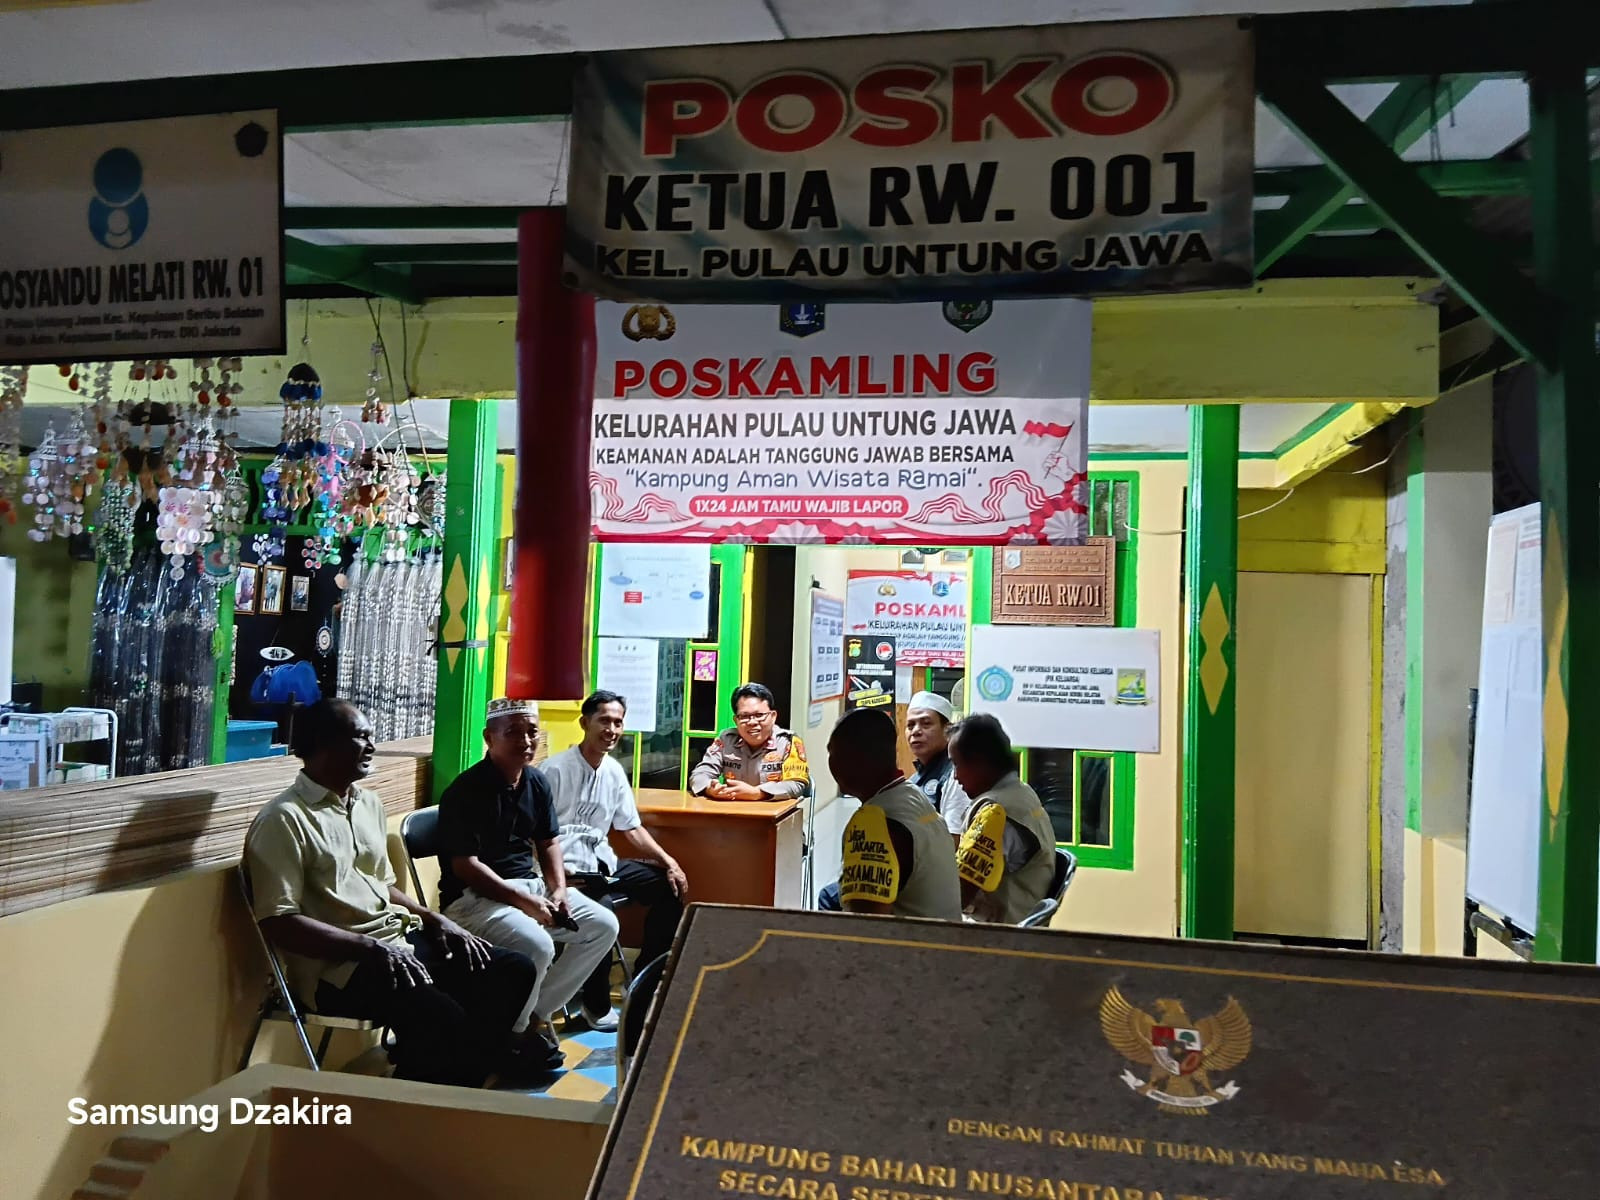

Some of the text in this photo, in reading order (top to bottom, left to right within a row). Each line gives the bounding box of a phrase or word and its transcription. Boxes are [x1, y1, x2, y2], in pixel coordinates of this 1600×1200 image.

[641, 54, 1173, 157] POSKO
[604, 151, 1208, 232] KETUA RW. 001
[598, 232, 1213, 278] KEL. PULAU UNTUNG JAWA
[108, 261, 185, 303] MELATI
[193, 259, 232, 299] RW.
[238, 256, 264, 297] 01
[613, 352, 996, 398] POSKAMLING
[595, 408, 1017, 438] KELURAHAN PULAU UNTUNG JAWA
[596, 445, 1014, 464] KEAMANAN ADALAH TANGGUNG JAWAB BERSAMA
[737, 470, 798, 488] Aman
[808, 469, 889, 488] Wisata
[695, 499, 902, 514] 1X24 JAM TAMU WAJIB LAPOR
[1004, 583, 1053, 606] KETUA
[868, 620, 919, 631] KELURAHAN
[680, 1135, 831, 1174] KAMPUNG
[840, 1154, 957, 1189] BAHARI
[946, 1118, 1447, 1187] DENGAN RAHMAT TUHAN YANG MAHA ESA
[719, 1169, 839, 1200] SECARA
